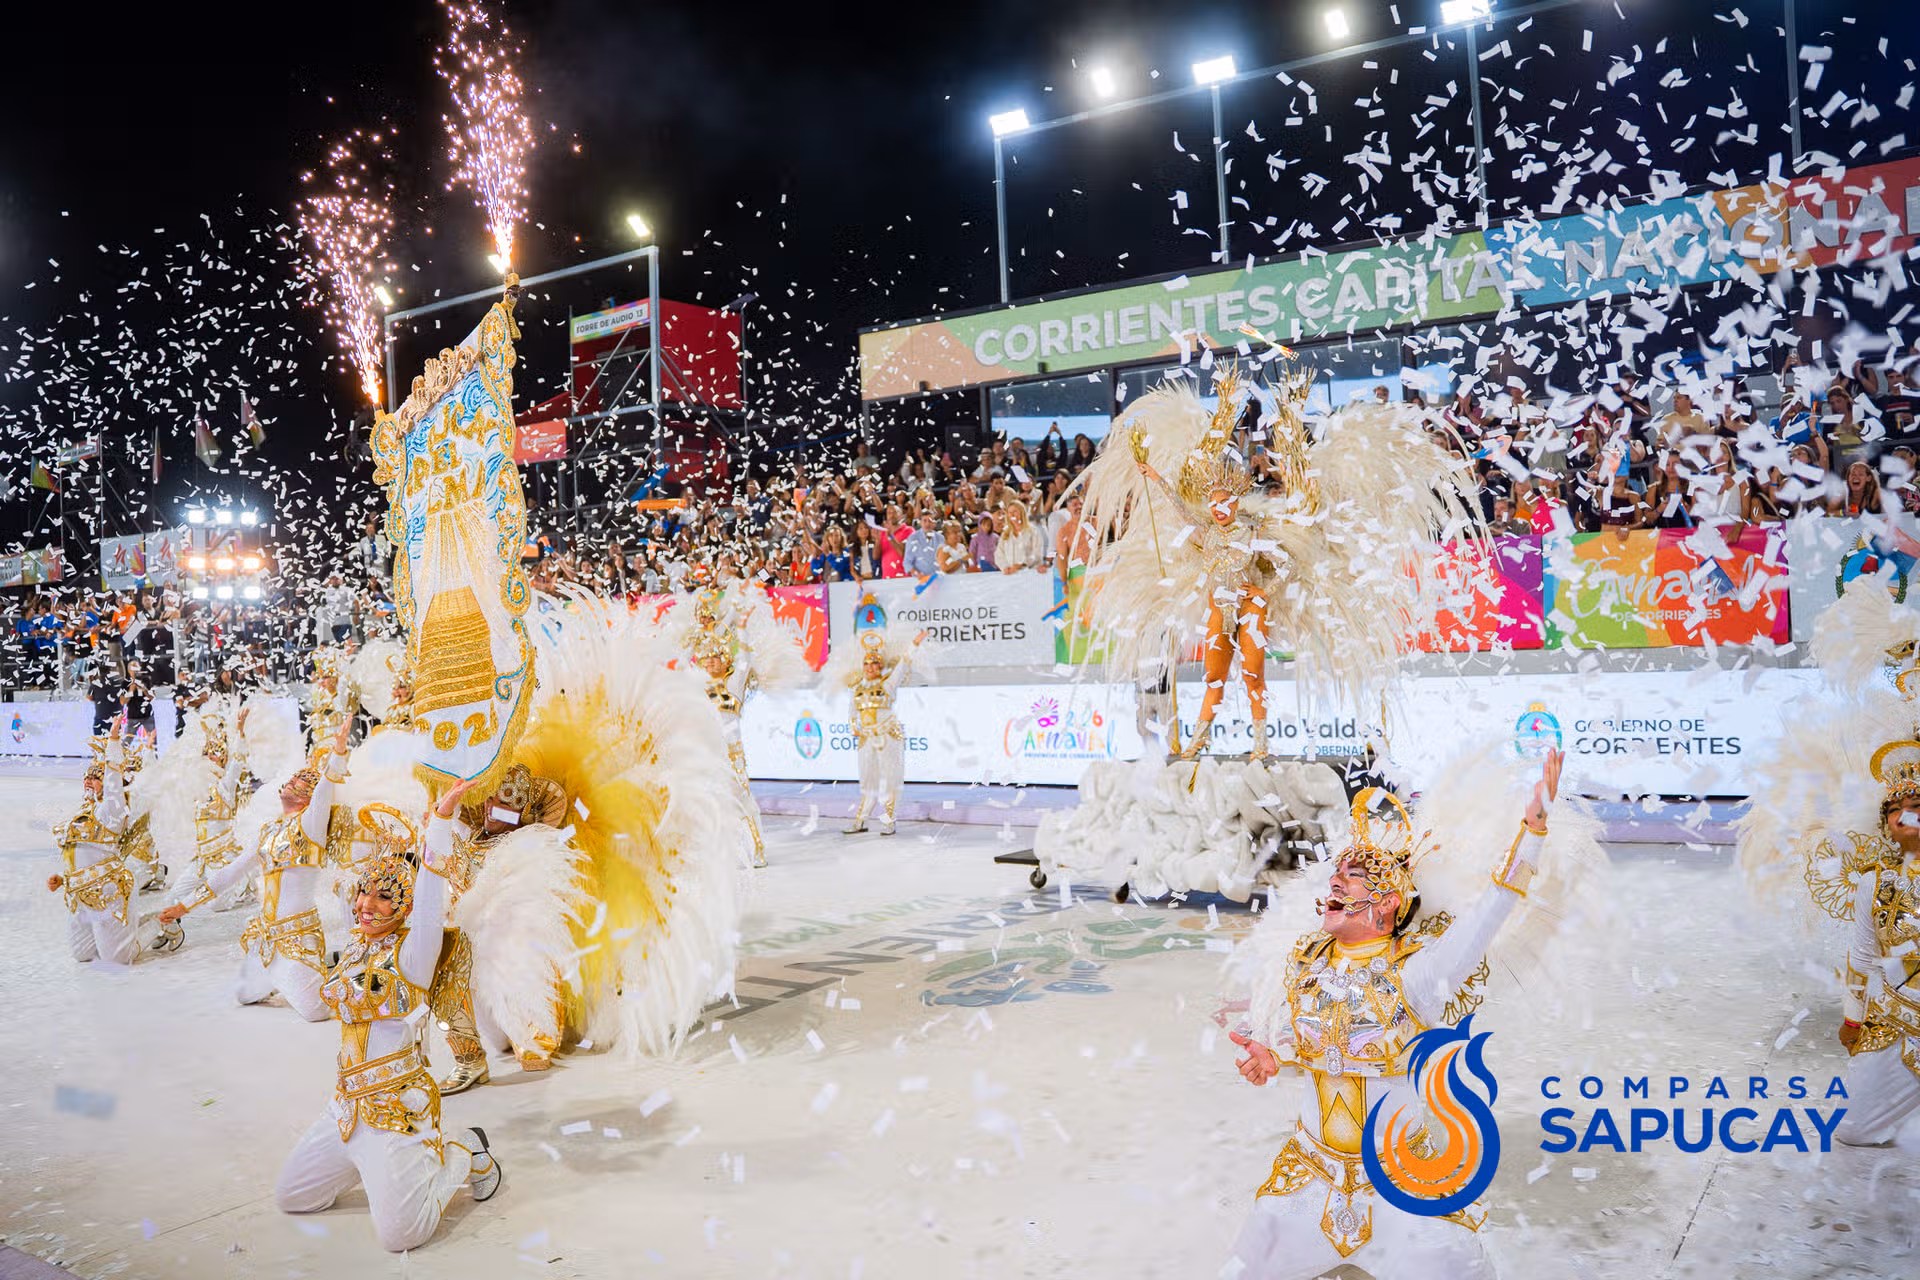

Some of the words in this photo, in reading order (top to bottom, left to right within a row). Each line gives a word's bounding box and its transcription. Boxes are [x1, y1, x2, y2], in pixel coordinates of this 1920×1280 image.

[576, 321, 599, 334] TORRE
[599, 318, 609, 328] DE
[610, 311, 634, 325] AUDIO
[974, 286, 1279, 367] CORRIENTES
[897, 607, 973, 622] GOBIERNO
[977, 606, 999, 620] DE
[1637, 607, 1722, 622] CORRIEES
[926, 622, 1026, 643] RRIENTES
[1178, 718, 1227, 739] Jun
[1679, 719, 1705, 732] DE
[1575, 737, 1742, 755] CORENTES
